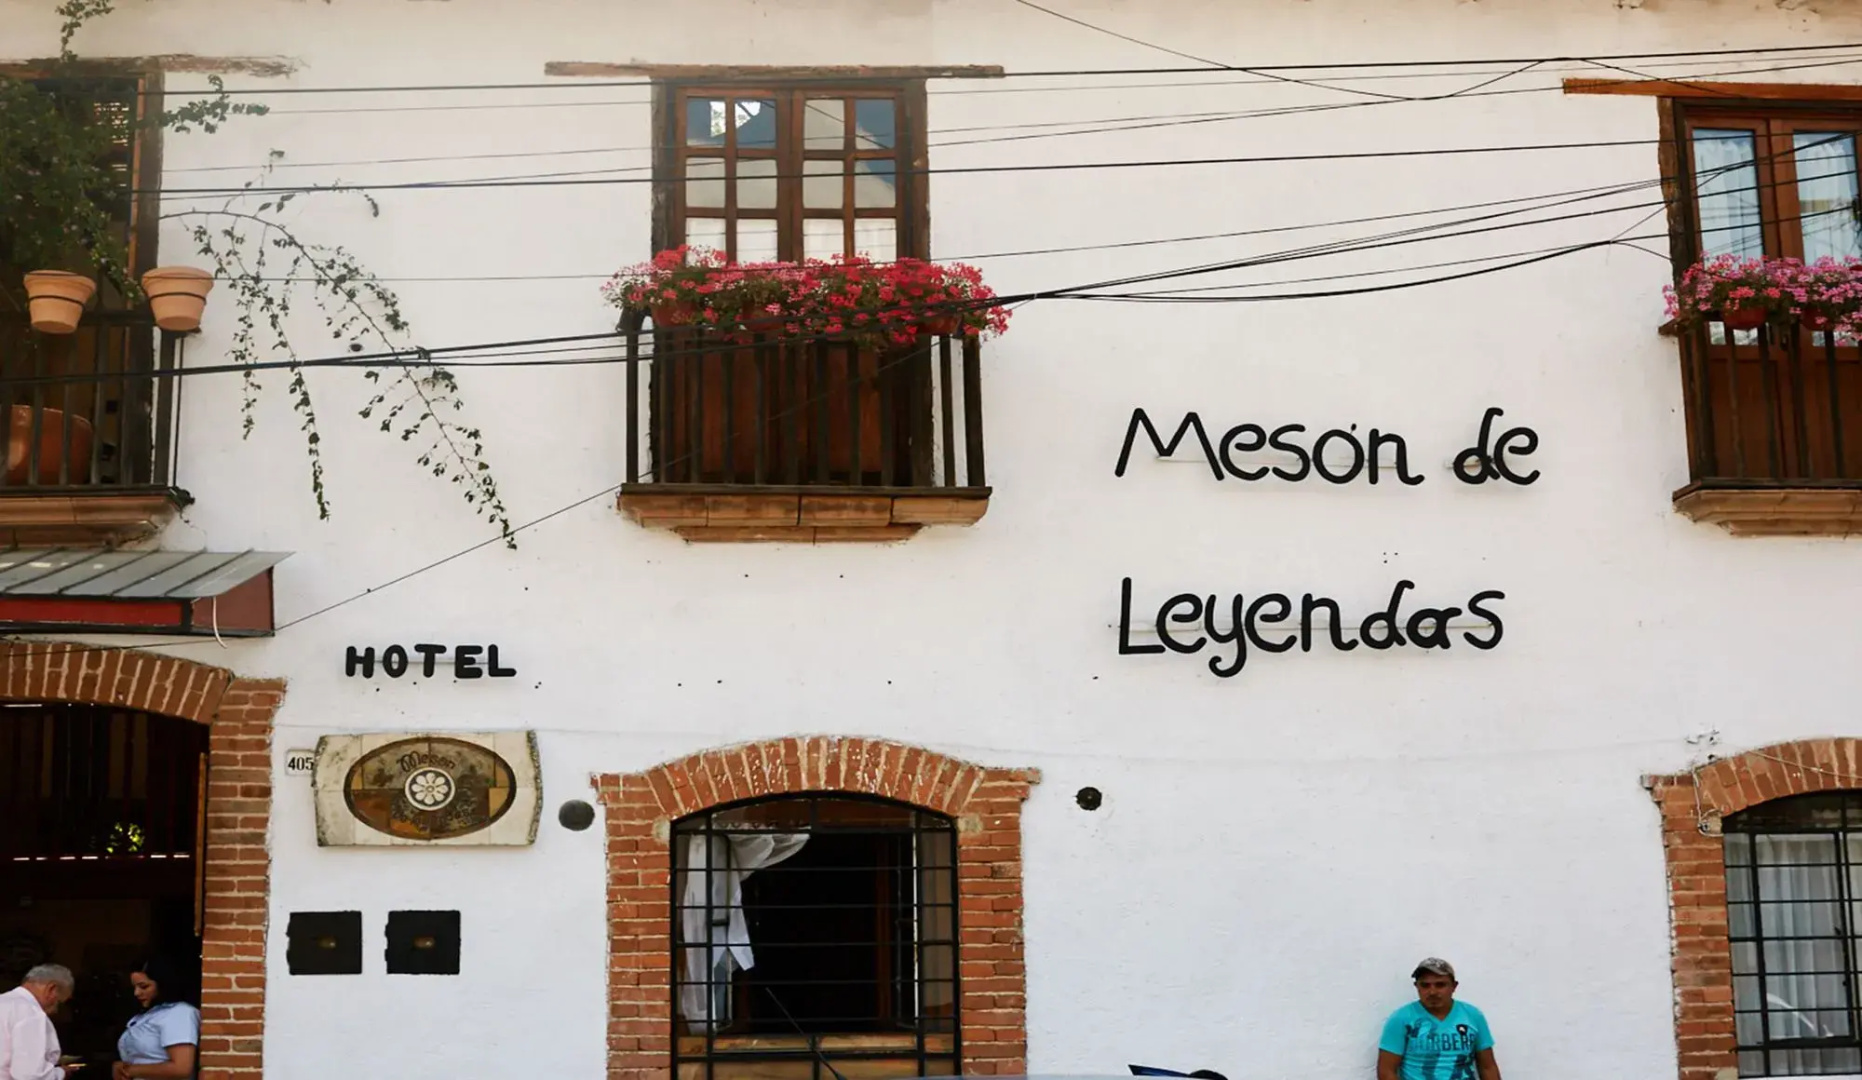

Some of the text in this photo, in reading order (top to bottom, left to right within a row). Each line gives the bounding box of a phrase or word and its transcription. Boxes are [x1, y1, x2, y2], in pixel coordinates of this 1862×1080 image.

[1452, 407, 1541, 486] de
[1118, 577, 1505, 678] Leyendas
[345, 643, 517, 679] HOTEL
[287, 755, 314, 771] 405
